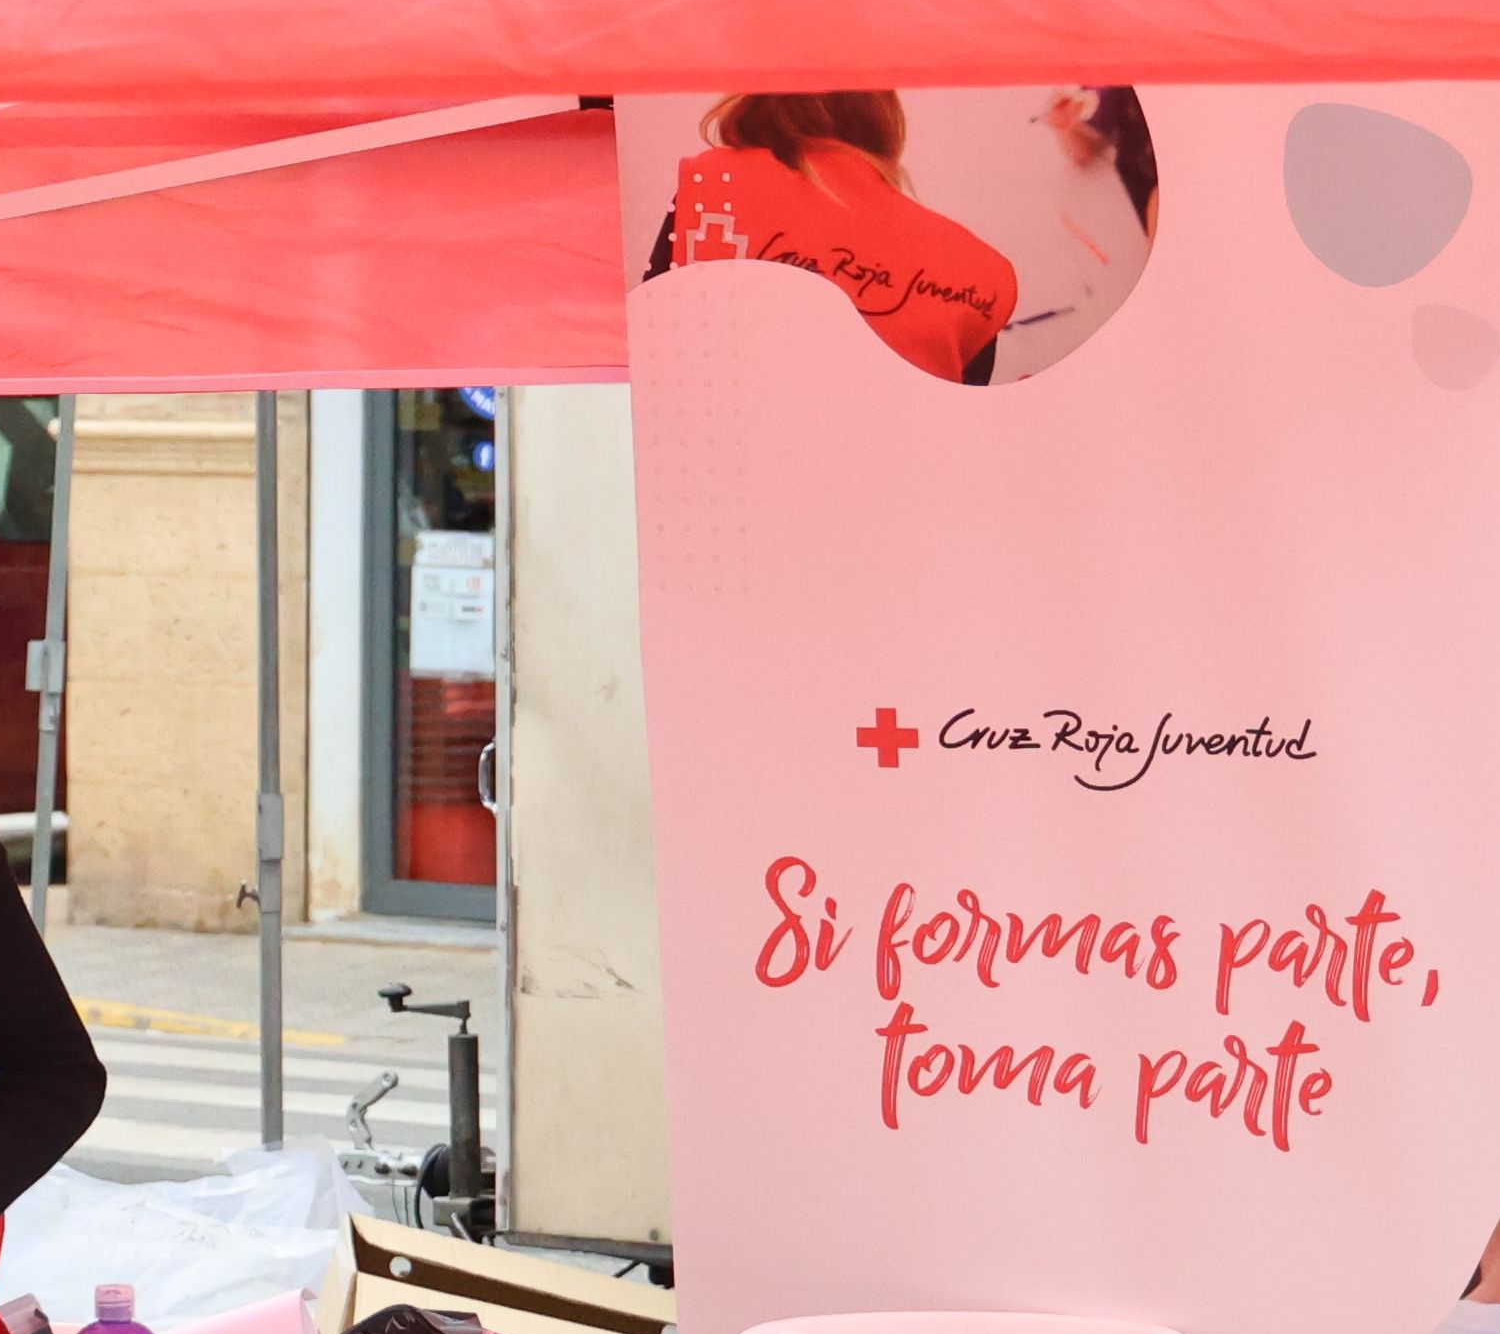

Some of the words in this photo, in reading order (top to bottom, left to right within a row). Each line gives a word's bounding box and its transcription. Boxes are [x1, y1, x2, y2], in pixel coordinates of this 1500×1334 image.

[831, 247, 893, 298] Roja
[937, 707, 1042, 752] Cruz
[1042, 709, 1141, 773] Roja
[1073, 712, 1318, 793] Juventud
[754, 855, 853, 989] Si
[876, 881, 1182, 1003] formas
[1215, 888, 1441, 1023] parte,
[874, 1001, 1102, 1132] toma
[1133, 1019, 1334, 1154] parte
